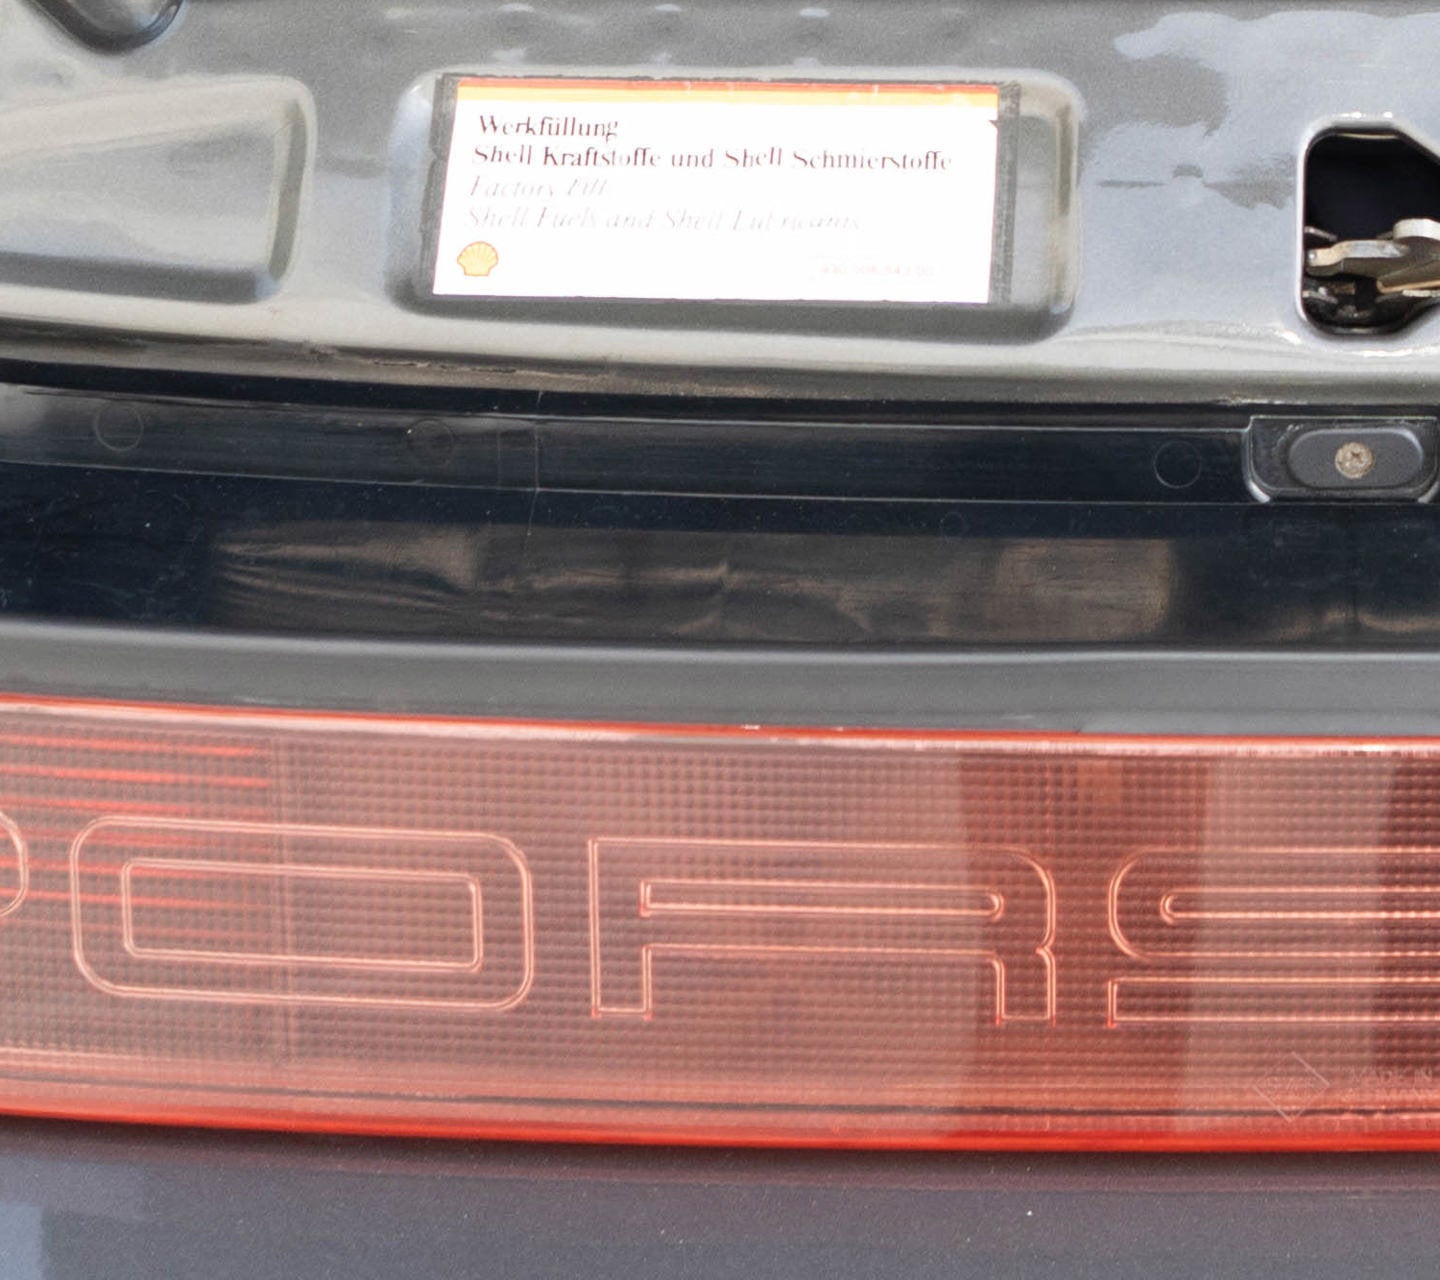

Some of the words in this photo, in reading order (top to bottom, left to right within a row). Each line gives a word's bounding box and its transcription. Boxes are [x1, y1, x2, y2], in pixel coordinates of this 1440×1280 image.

[478, 114, 619, 142] Werkfüllung
[473, 144, 532, 166] Shell
[542, 146, 661, 170] Kraftstoffe
[671, 150, 715, 169] und
[724, 148, 783, 170] Shell
[791, 147, 952, 172] Schmierstoffe
